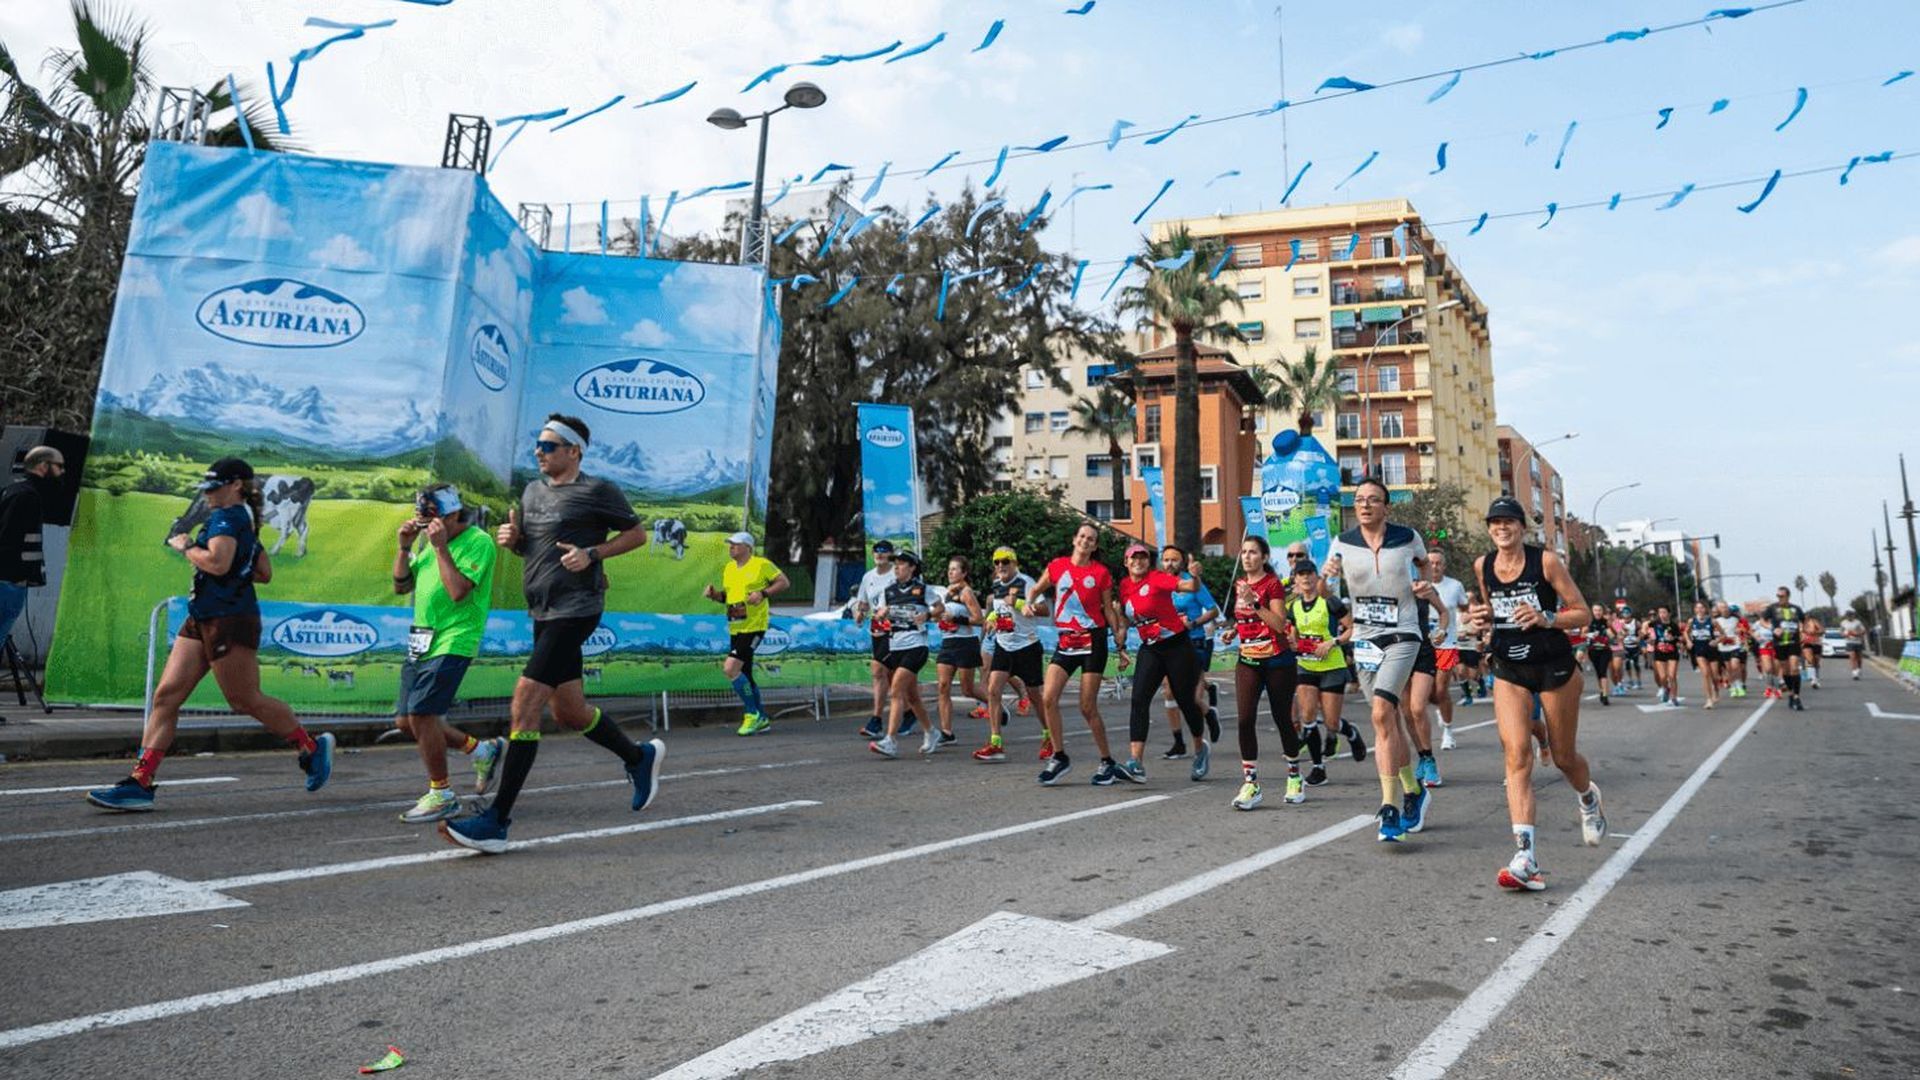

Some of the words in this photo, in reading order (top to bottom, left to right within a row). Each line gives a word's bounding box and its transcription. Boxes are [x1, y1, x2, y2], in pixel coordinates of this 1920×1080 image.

[208, 299, 352, 336] ASTURIANA
[583, 376, 695, 402] ASTURIANA
[281, 623, 372, 645] ASTURIANA
